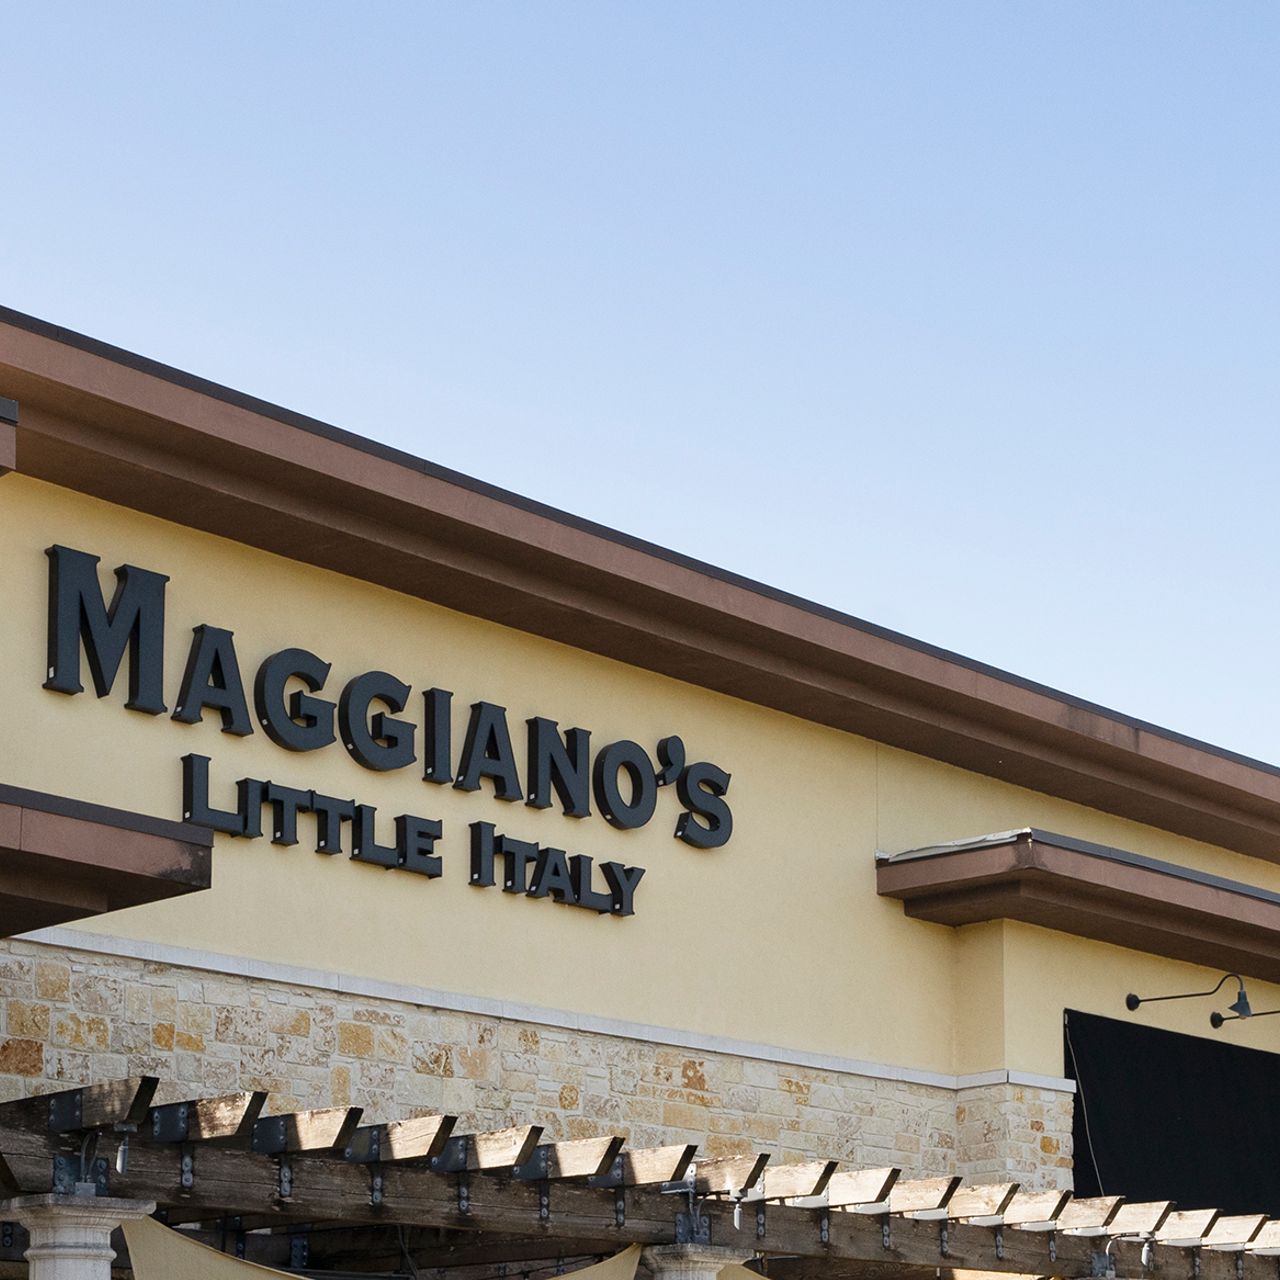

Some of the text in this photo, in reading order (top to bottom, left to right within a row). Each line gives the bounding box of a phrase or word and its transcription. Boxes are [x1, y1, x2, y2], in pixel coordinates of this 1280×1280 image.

[42, 544, 734, 849] MAGGIANO'S
[181, 752, 646, 917] LITTLE ITALY
